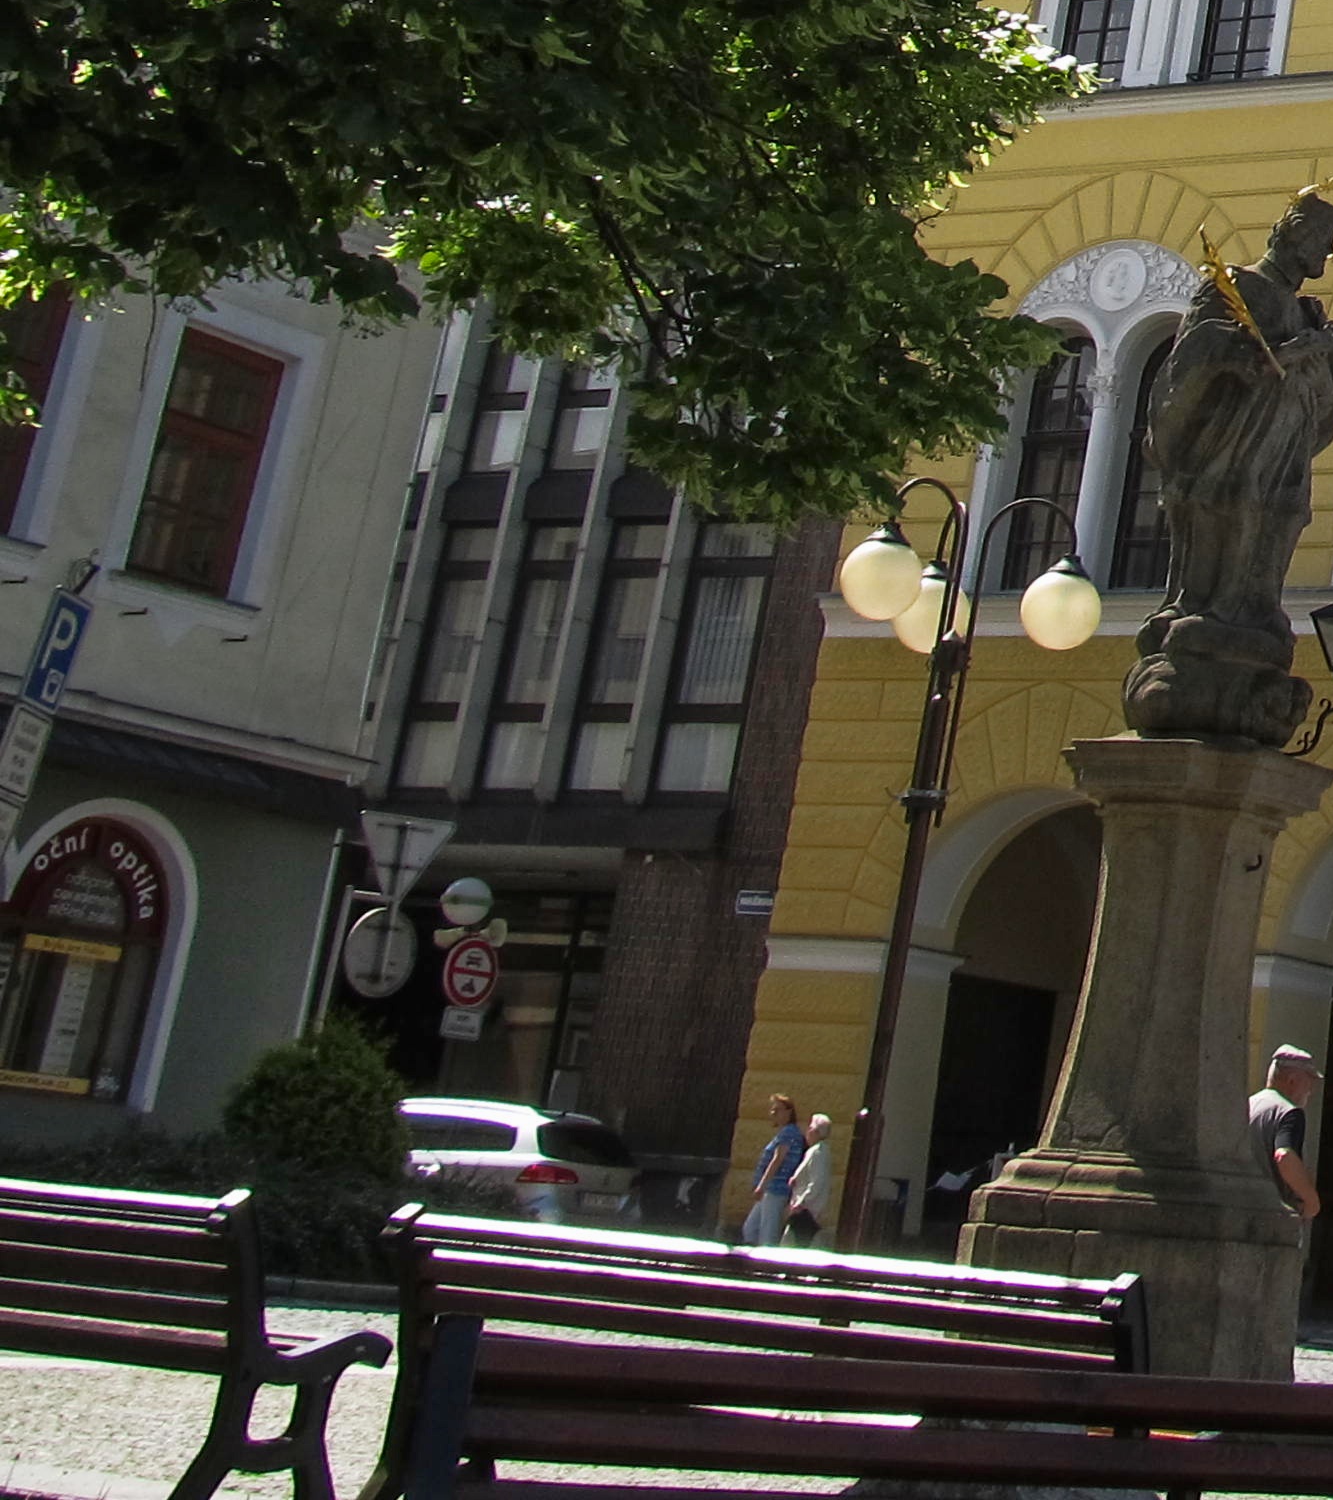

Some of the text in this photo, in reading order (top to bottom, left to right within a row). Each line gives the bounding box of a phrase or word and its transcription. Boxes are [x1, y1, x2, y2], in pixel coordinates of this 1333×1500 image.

[40, 607, 78, 669] P
[34, 827, 158, 919] oční optika
